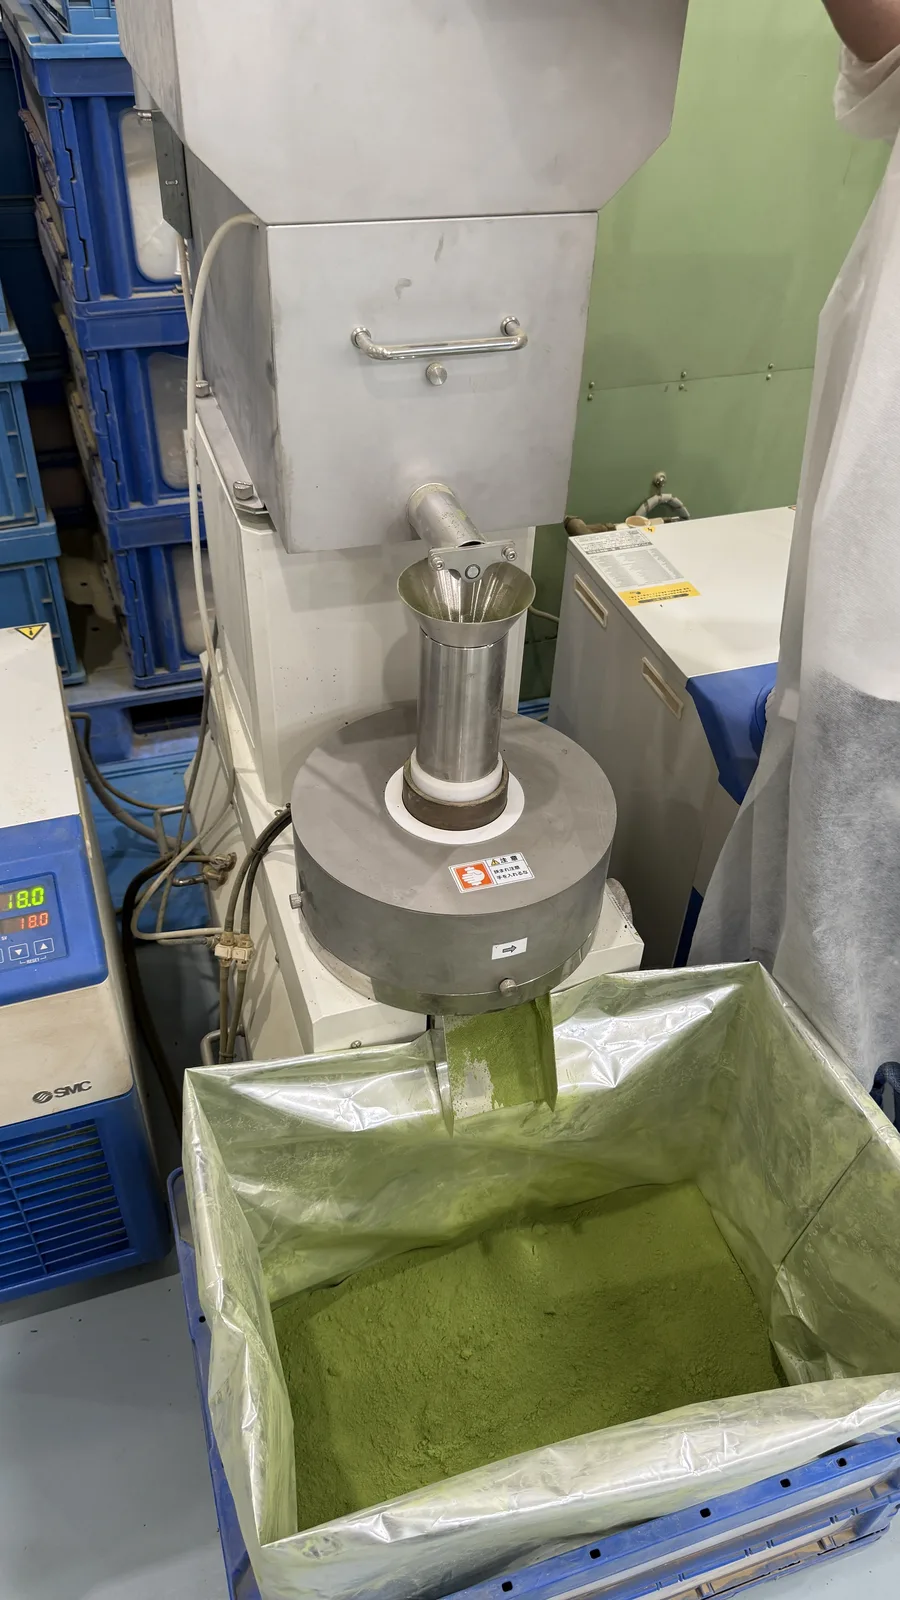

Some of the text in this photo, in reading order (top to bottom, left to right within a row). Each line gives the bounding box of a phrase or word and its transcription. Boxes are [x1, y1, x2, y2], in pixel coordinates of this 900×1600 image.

[8, 887, 44, 909] 18.0
[21, 912, 48, 930] 18.0
[54, 1081, 92, 1098] SMC
